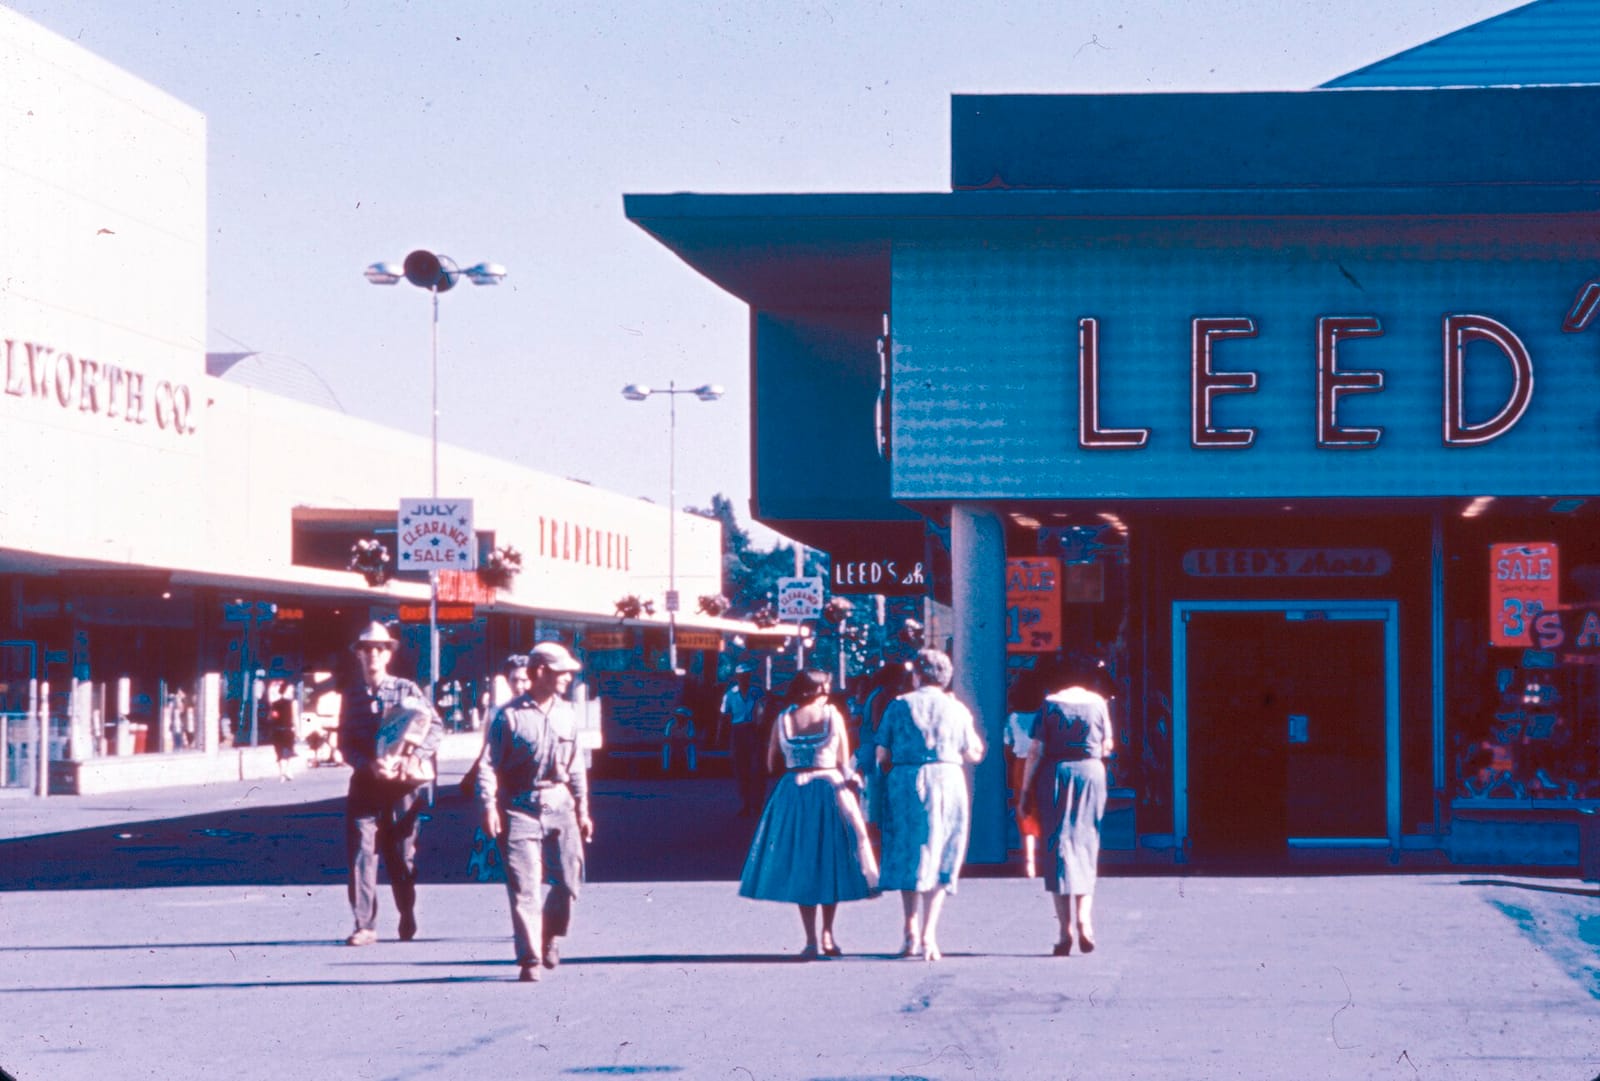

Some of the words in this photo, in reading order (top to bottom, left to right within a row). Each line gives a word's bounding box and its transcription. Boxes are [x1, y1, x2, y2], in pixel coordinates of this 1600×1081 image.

[410, 504, 459, 516] JULY
[402, 520, 469, 547] CLEARANCE
[414, 549, 456, 562] SALE
[1197, 551, 1289, 573] LEED'S
[835, 559, 898, 584] LEED'S
[1496, 558, 1552, 581] SALE
[1007, 571, 1055, 591] ALE
